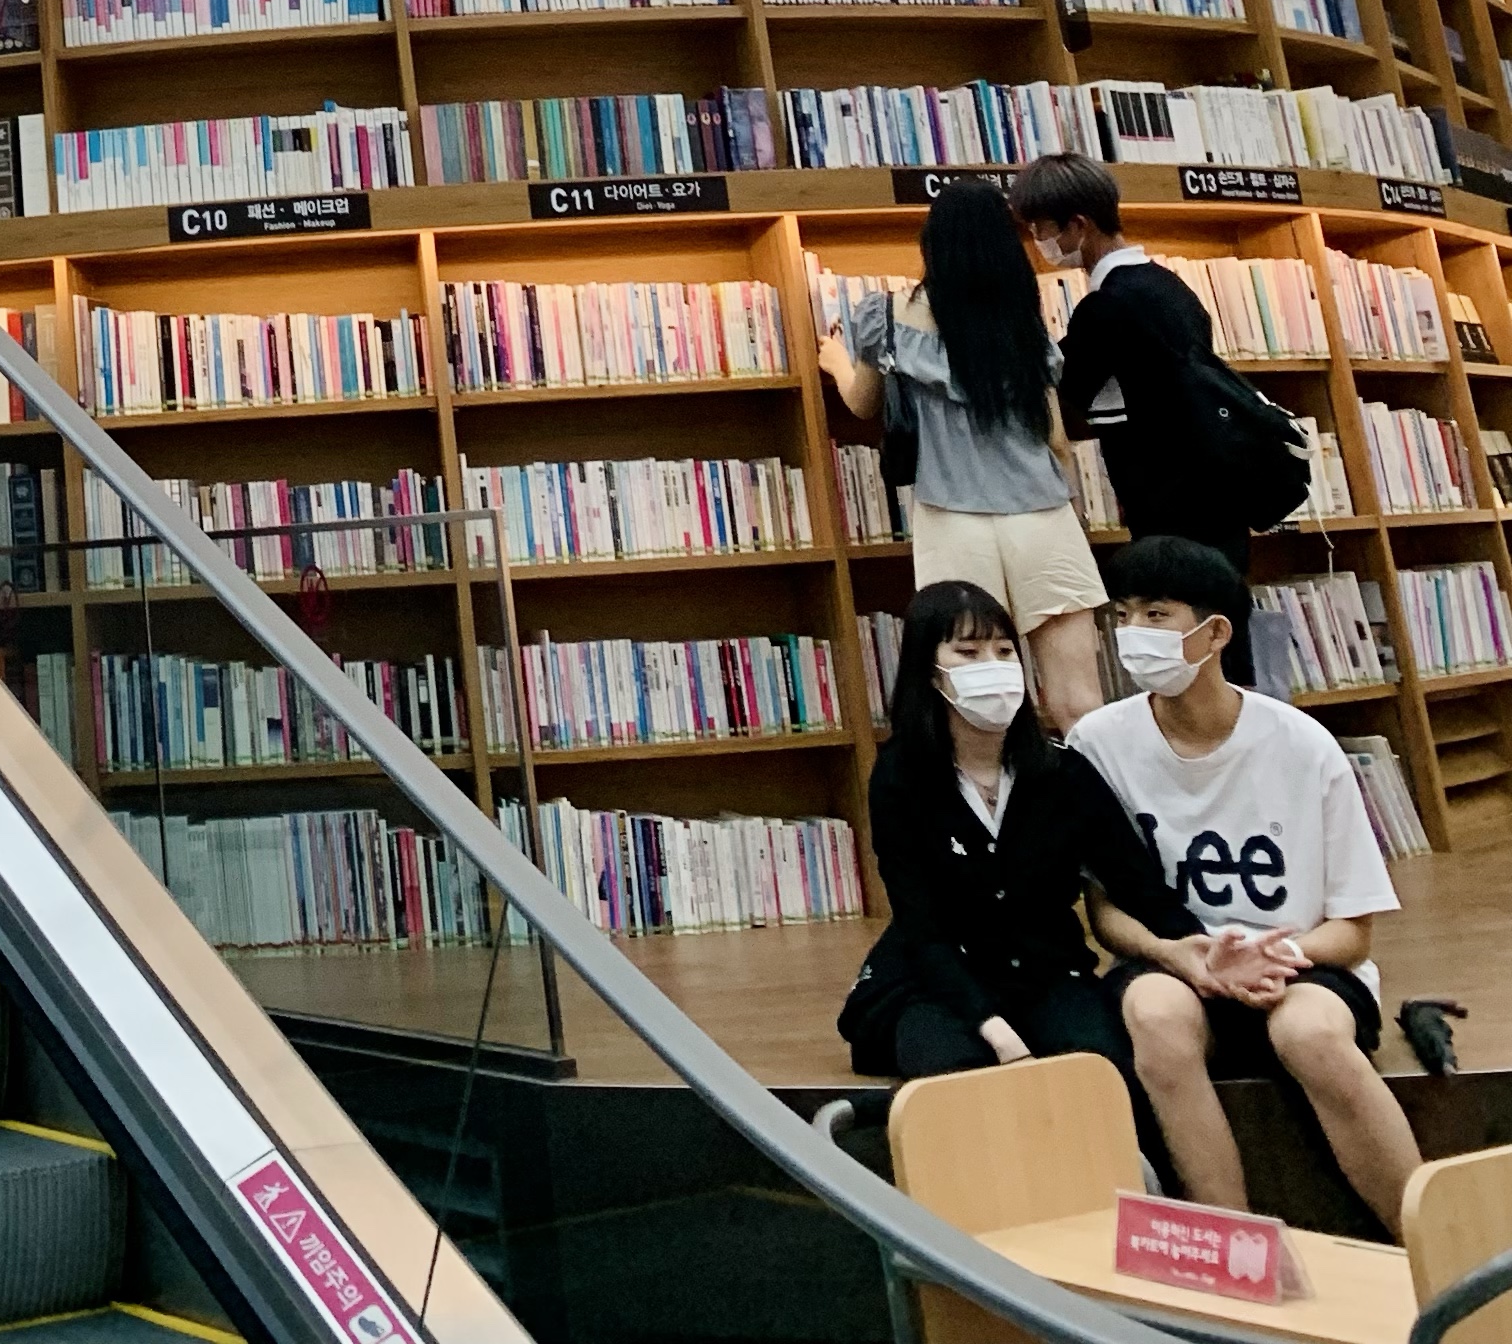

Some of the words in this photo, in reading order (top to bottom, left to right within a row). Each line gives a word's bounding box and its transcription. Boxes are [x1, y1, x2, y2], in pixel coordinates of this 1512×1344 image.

[603, 182, 664, 201] 다이어트
[671, 180, 702, 198] 요가
[1184, 169, 1218, 195] C13
[247, 201, 276, 220] 패션
[293, 196, 350, 216] 메이크업
[549, 186, 595, 213] C11
[656, 201, 677, 211] Yoga
[181, 208, 229, 235] C10
[263, 221, 297, 231] Fashion
[302, 218, 336, 230] Makeup
[298, 1232, 365, 1313] 끼임주의
